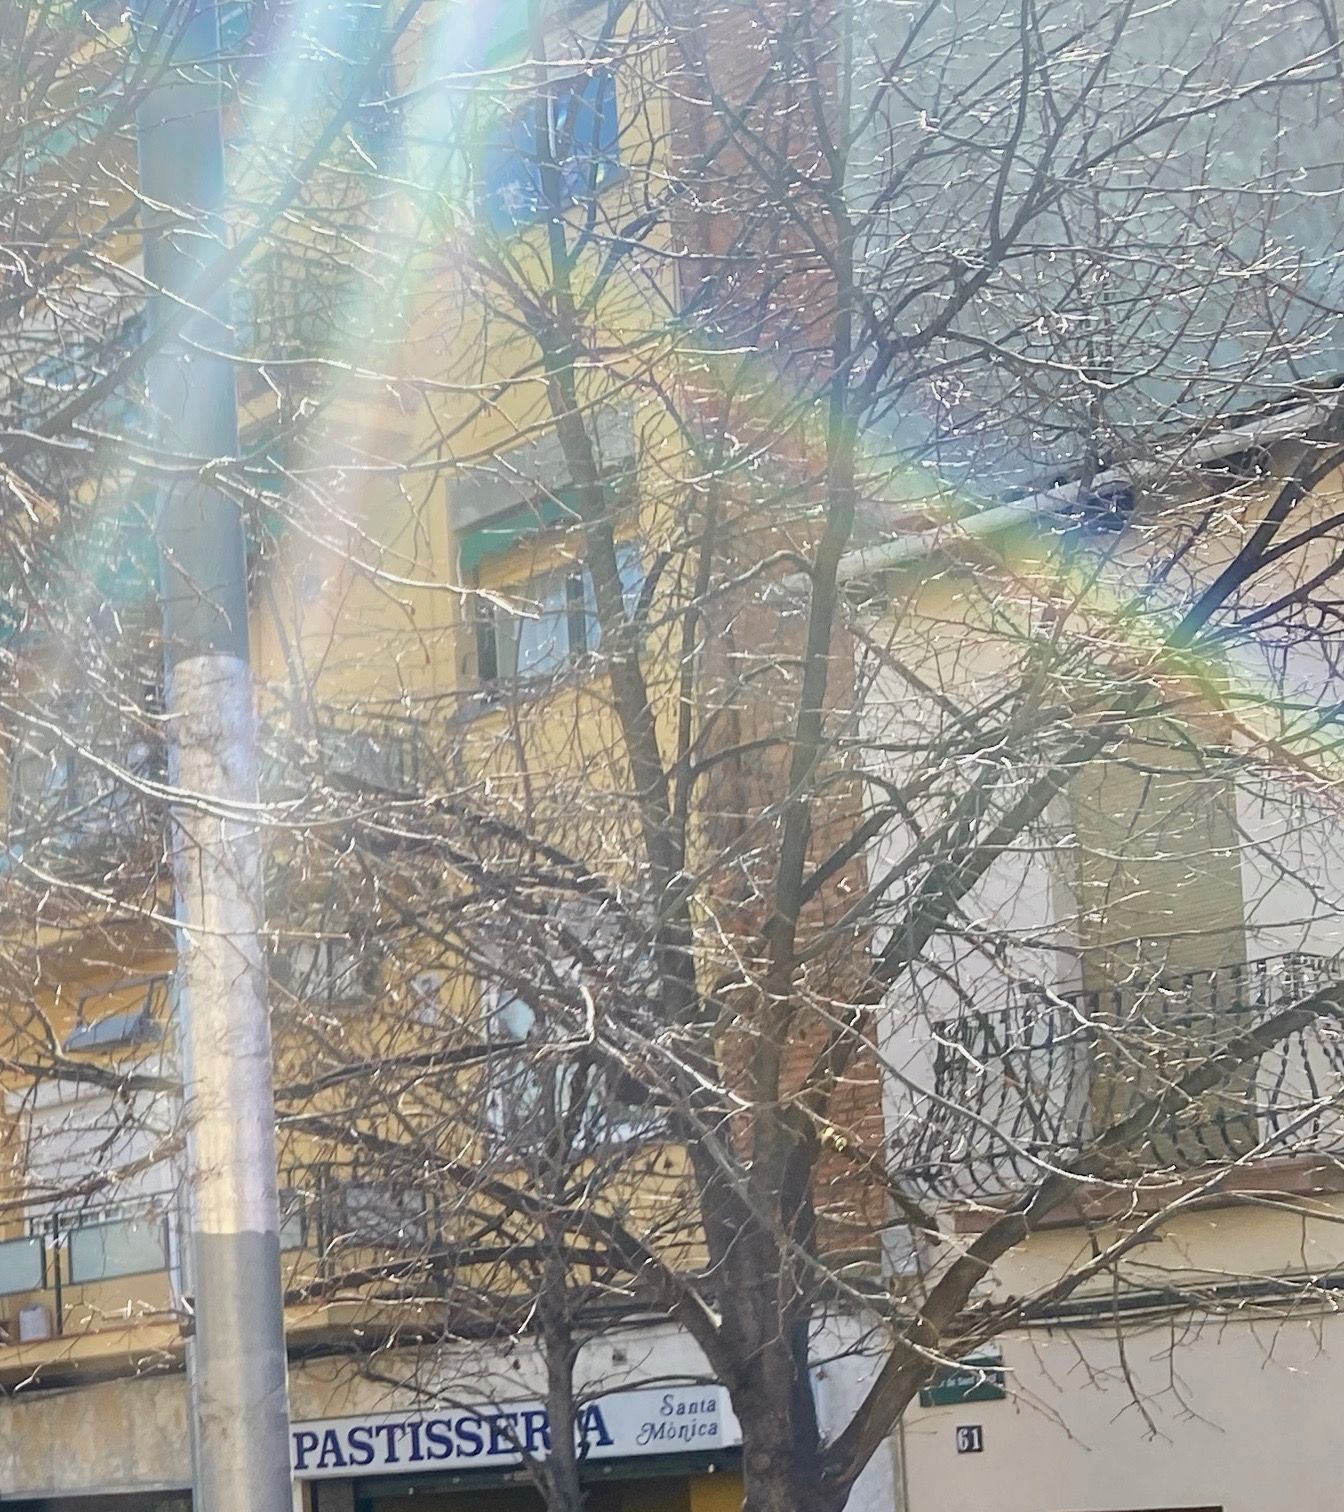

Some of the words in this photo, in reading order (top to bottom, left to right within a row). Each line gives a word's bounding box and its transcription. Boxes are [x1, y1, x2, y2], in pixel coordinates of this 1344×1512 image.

[660, 1394, 716, 1416] Santa
[293, 1405, 615, 1470] PASTISSERA
[635, 1418, 718, 1446] Mònica
[957, 1427, 981, 1451] 61
